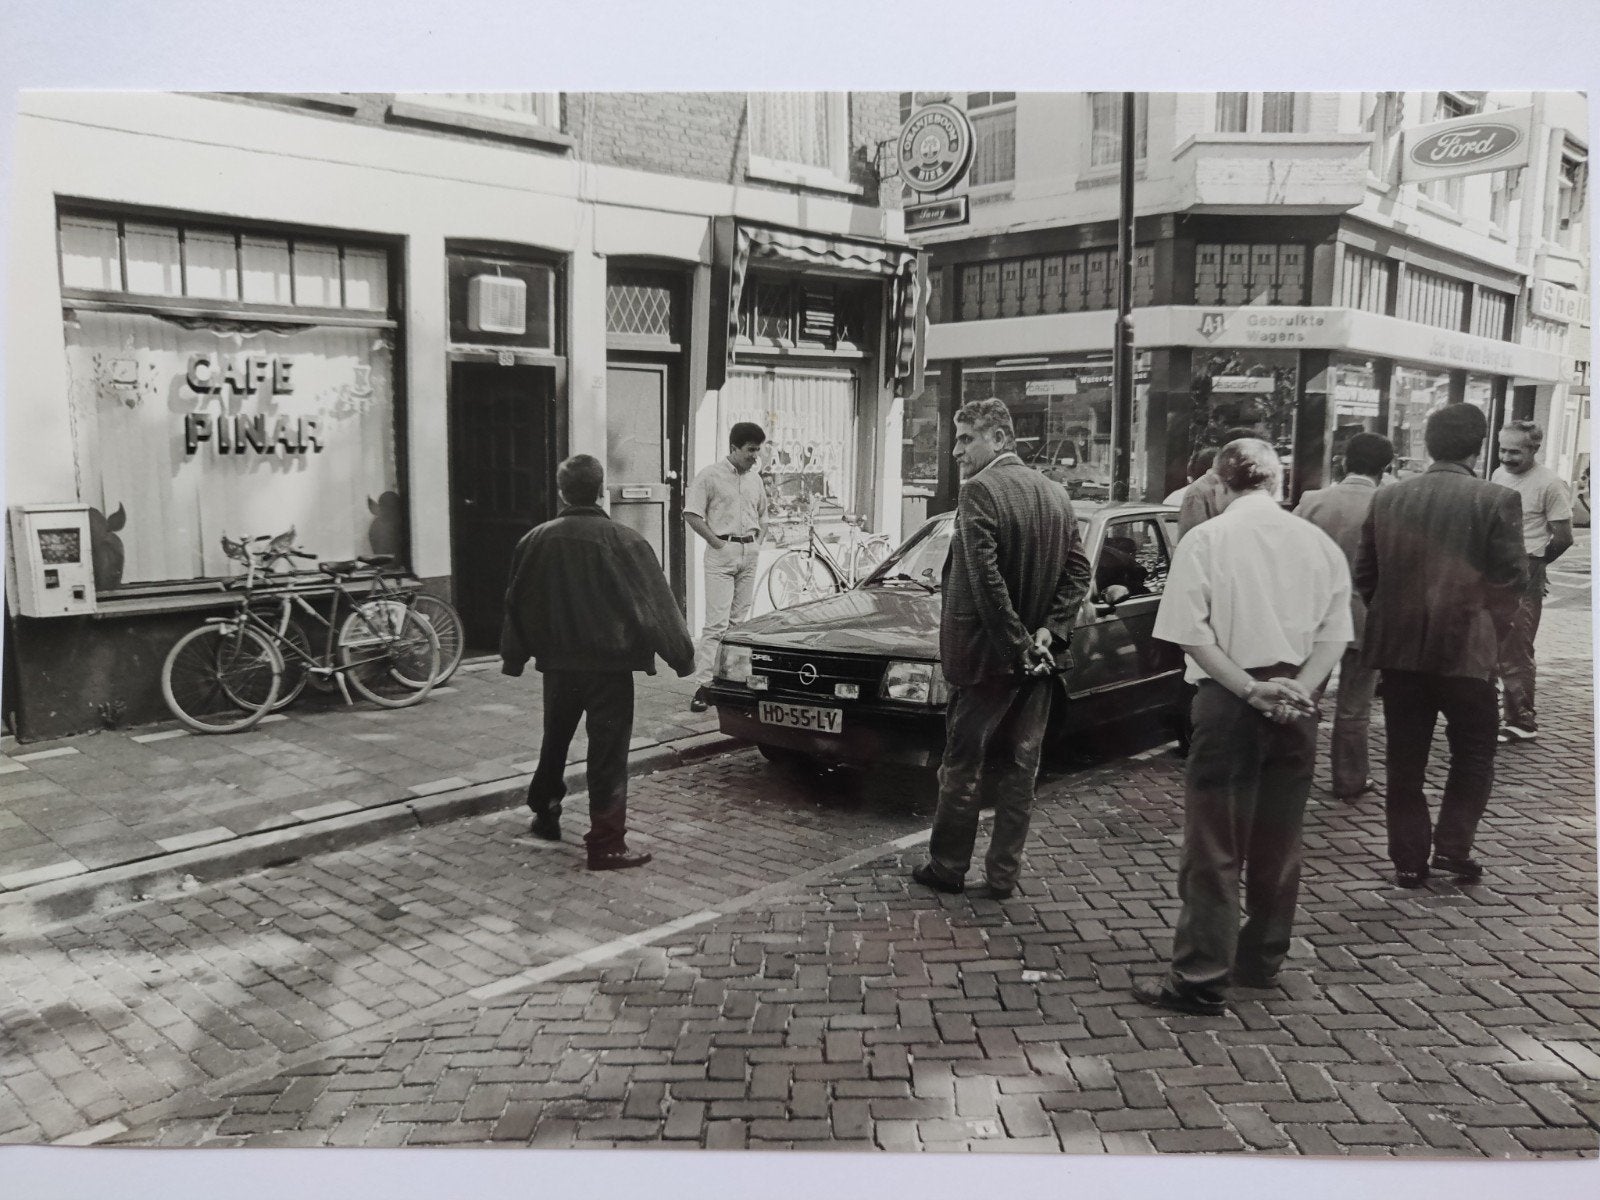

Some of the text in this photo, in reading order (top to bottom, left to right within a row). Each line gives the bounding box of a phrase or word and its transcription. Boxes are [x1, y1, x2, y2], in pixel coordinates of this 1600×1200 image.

[1430, 129, 1495, 161] Ford
[918, 167, 945, 181] BIER
[1247, 314, 1325, 327] Gebruikte
[1247, 332, 1304, 343] Wagens
[186, 353, 294, 395] CAFE
[185, 413, 324, 454] PINAR
[751, 653, 773, 662] OPEL
[763, 703, 837, 730] HD-55-LV
